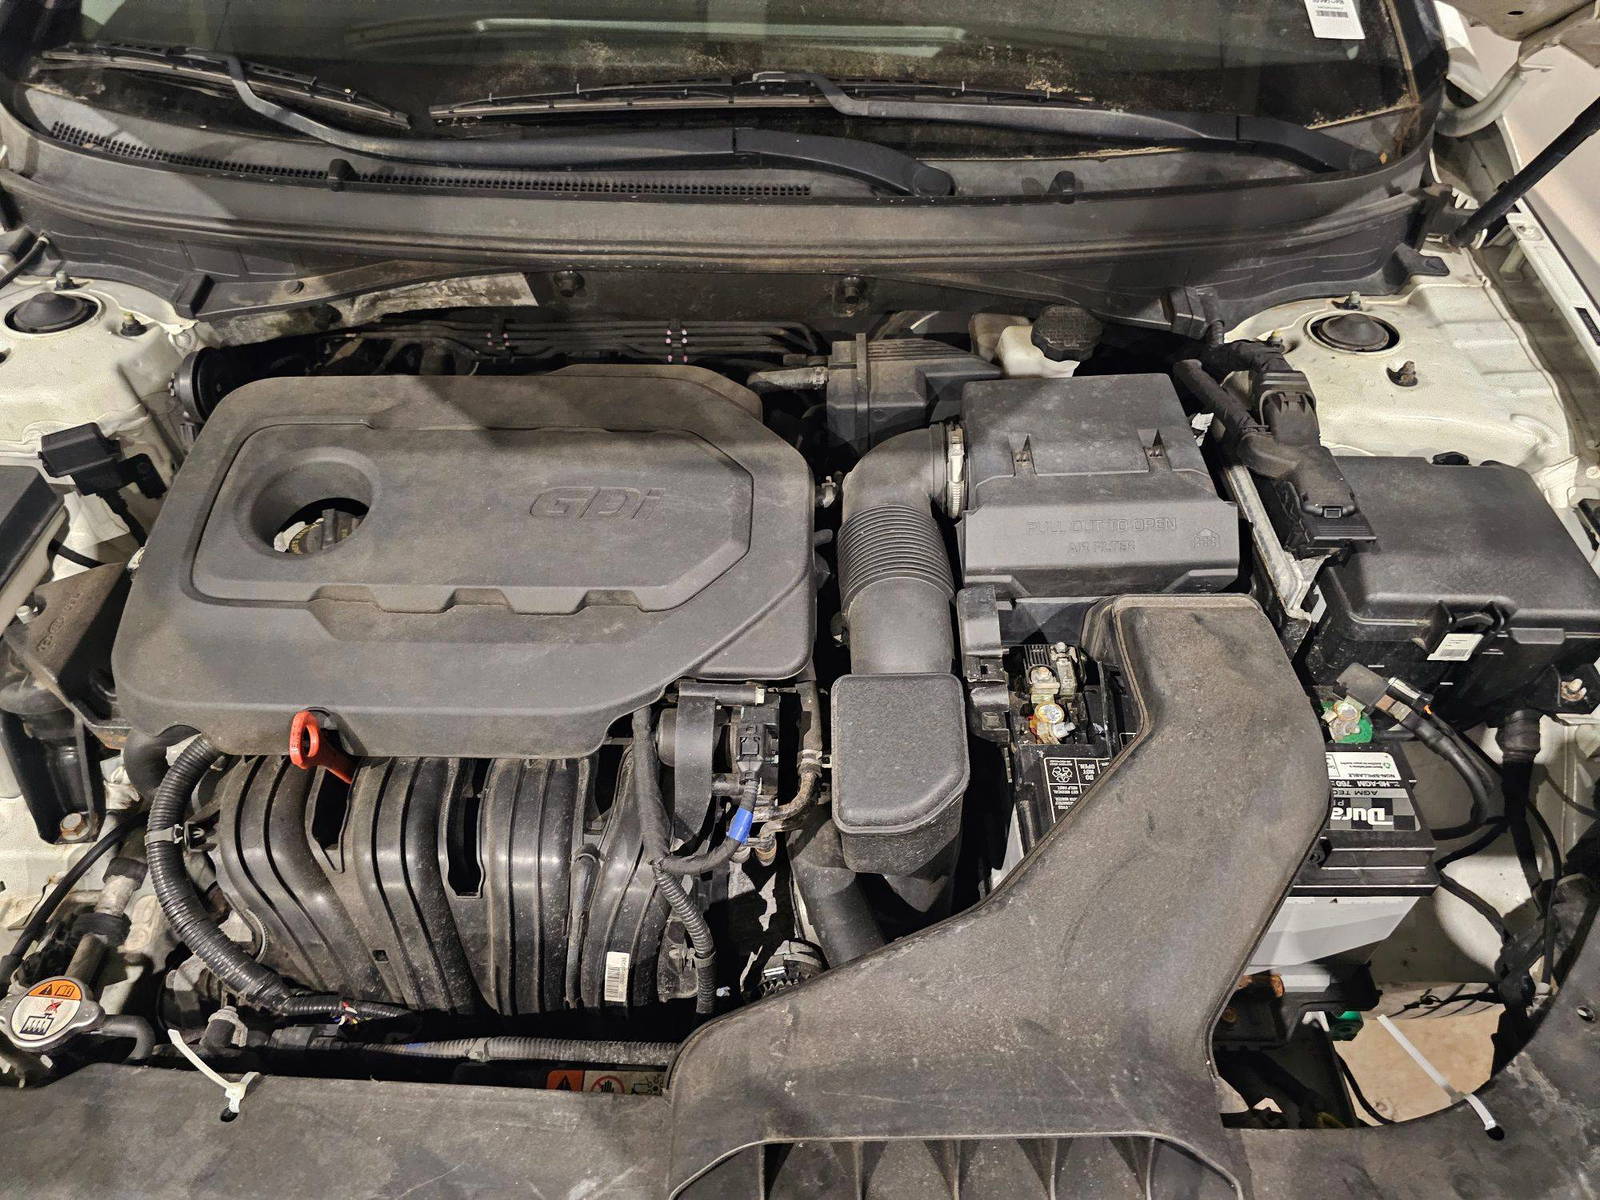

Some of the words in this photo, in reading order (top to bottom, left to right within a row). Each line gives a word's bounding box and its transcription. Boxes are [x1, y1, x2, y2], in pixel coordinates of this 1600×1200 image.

[1026, 520, 1066, 536] PULL
[1071, 519, 1105, 534] OUT
[1109, 518, 1128, 533] TO
[1134, 517, 1177, 532] OPEN
[1069, 541, 1090, 553] AIR
